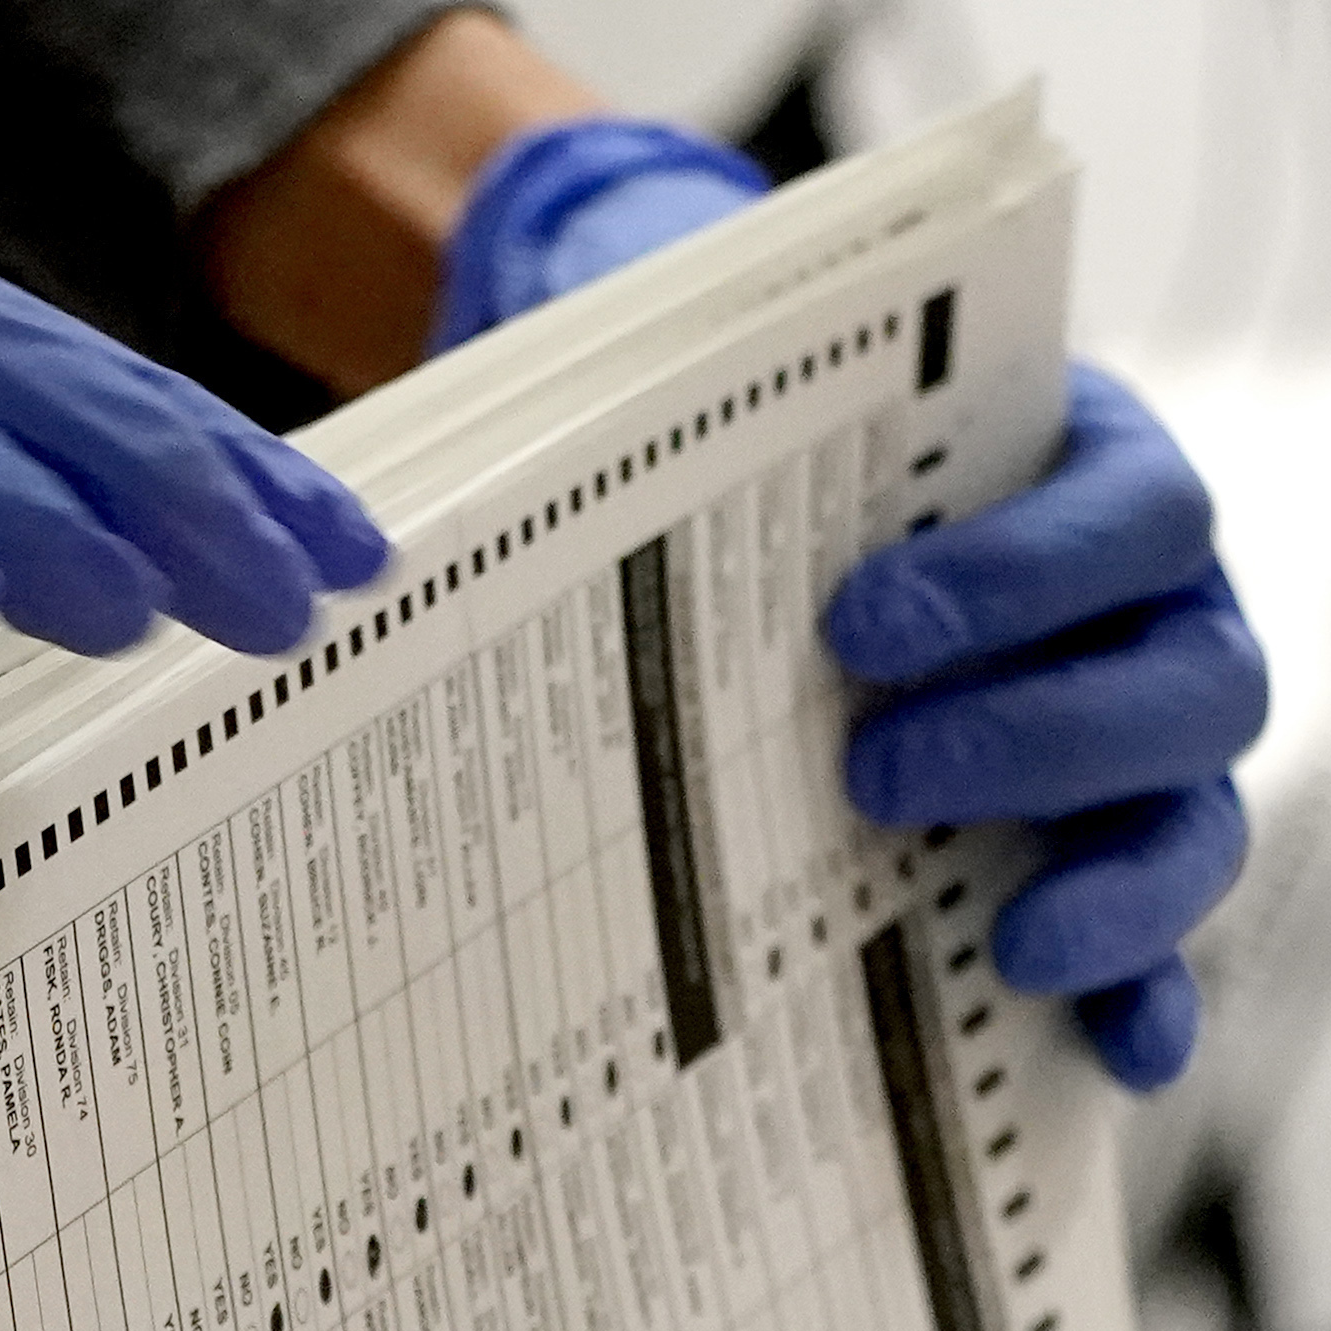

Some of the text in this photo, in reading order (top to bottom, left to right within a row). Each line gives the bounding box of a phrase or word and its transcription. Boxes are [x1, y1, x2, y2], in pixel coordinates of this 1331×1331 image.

[42, 943, 58, 1001] FISK,
[49, 1003, 68, 1083] RONDA
[56, 933, 89, 1121] Retain: Division 74
[93, 909, 122, 1067] DRIGGS, ADAM
[107, 899, 139, 1086] Retain: Division 75
[155, 960, 183, 1113] CHRISTOPHER
[0, 1063, 21, 1155] PAMELA
[2, 970, 38, 1158] Retain: Division 30
